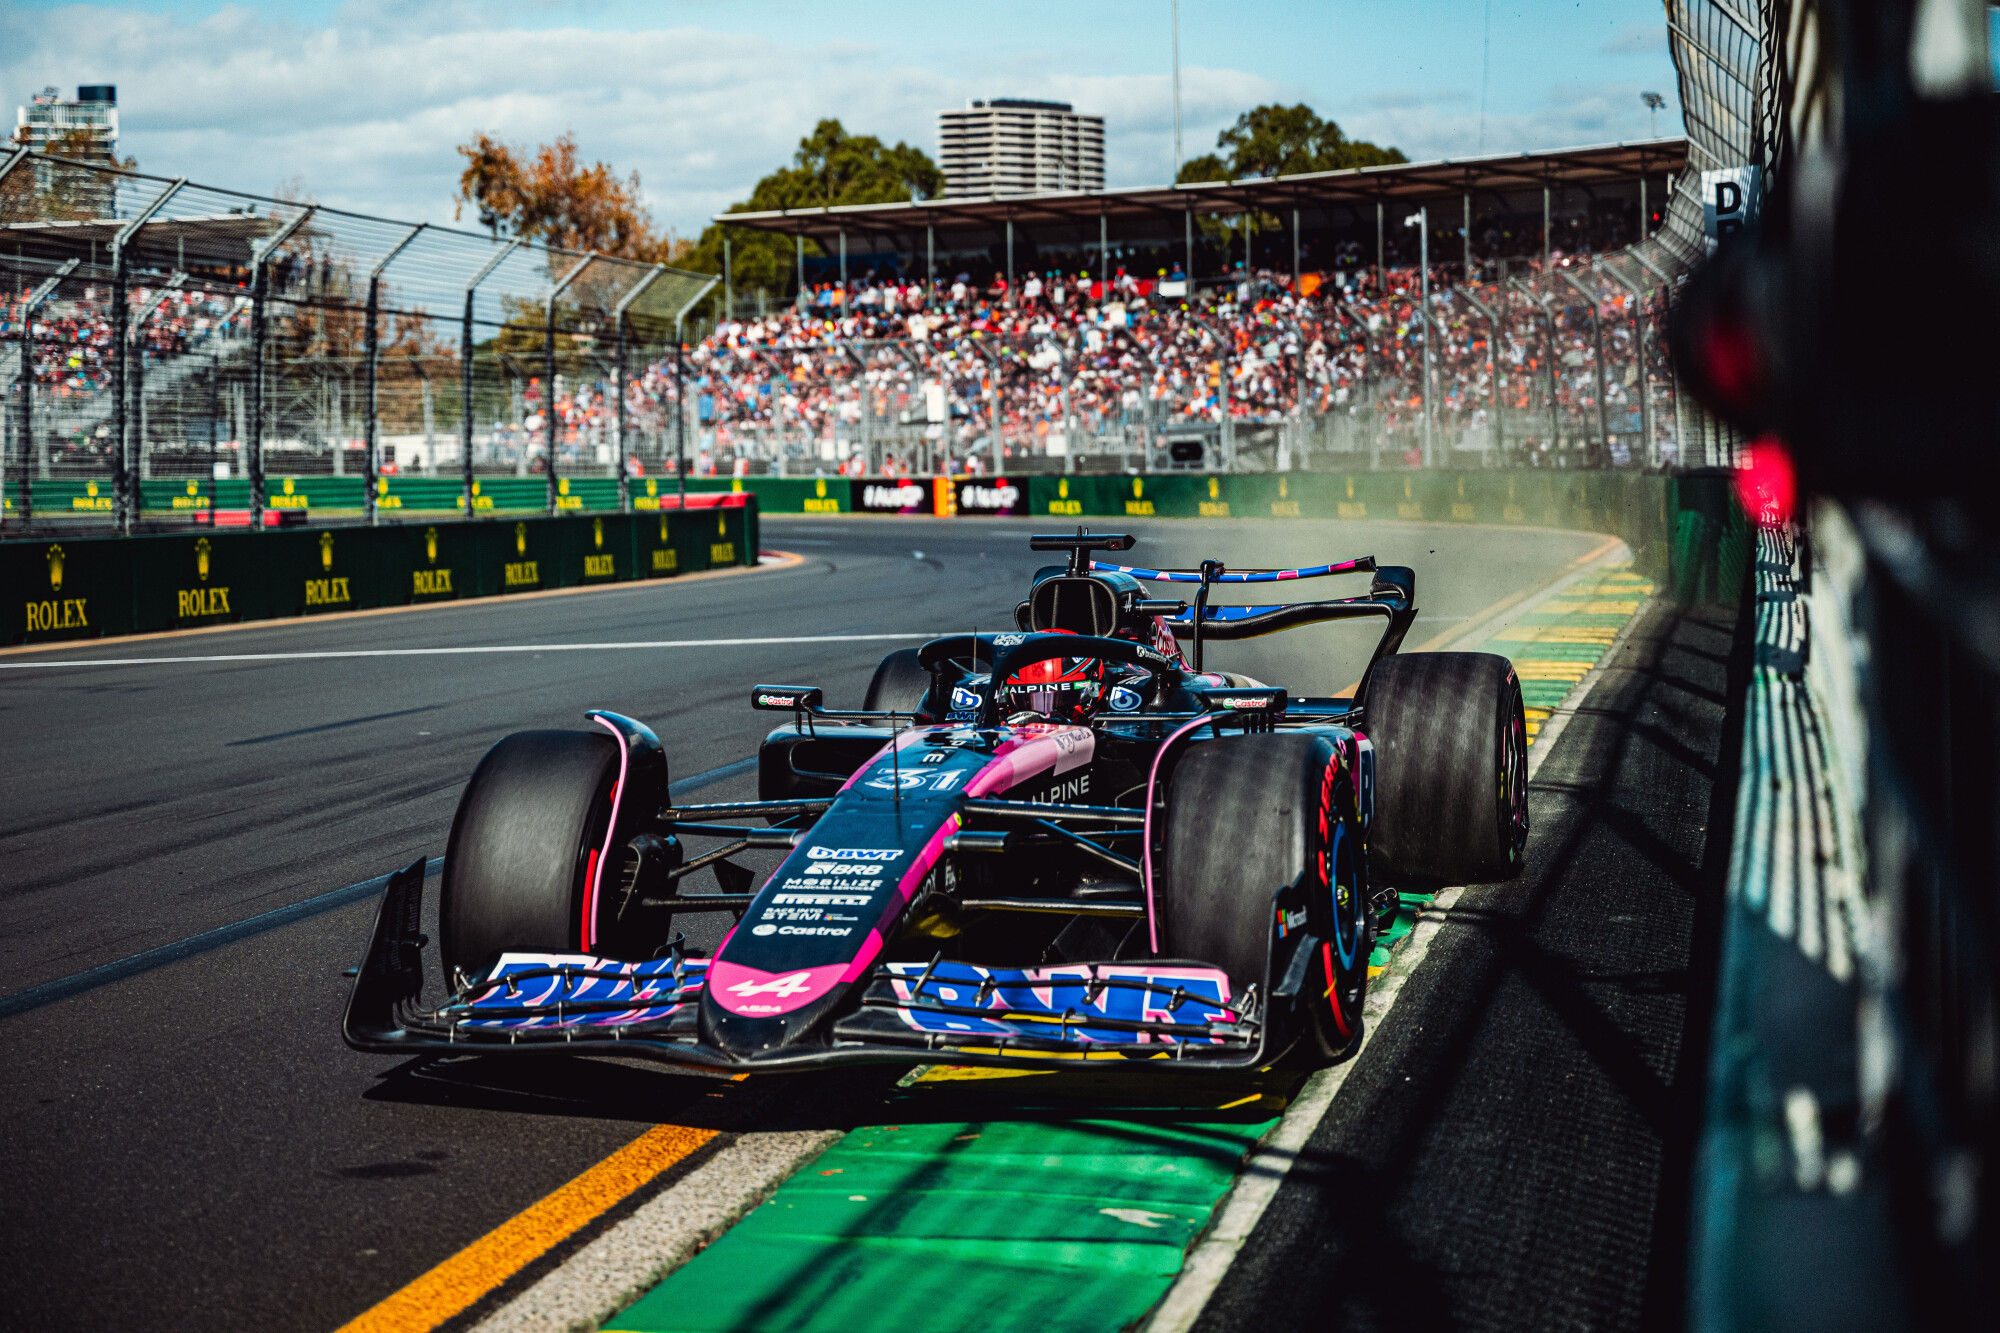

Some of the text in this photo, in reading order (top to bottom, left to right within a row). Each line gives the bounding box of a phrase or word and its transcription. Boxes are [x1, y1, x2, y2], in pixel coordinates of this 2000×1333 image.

[1715, 181, 1741, 216] D
[653, 549, 676, 569] ROLEX
[711, 543, 735, 562] ROLEX
[505, 561, 538, 585] ROLEX
[585, 555, 614, 576] ROLEX
[306, 577, 350, 605] ROLEX
[413, 569, 452, 594] ROLEX
[178, 587, 230, 617] ROLEX
[26, 598, 88, 632] ROLEX
[1009, 682, 1071, 693] ALPINE
[767, 697, 795, 706] Castrol
[1224, 698, 1267, 708] Castrol
[865, 768, 967, 791] 31
[835, 848, 904, 860] BWT
[831, 865, 883, 875] BRB
[785, 877, 884, 888] MOBILIZE
[771, 893, 873, 906] PIRELLI
[761, 912, 822, 921] STEM
[778, 926, 853, 936] Castrol
